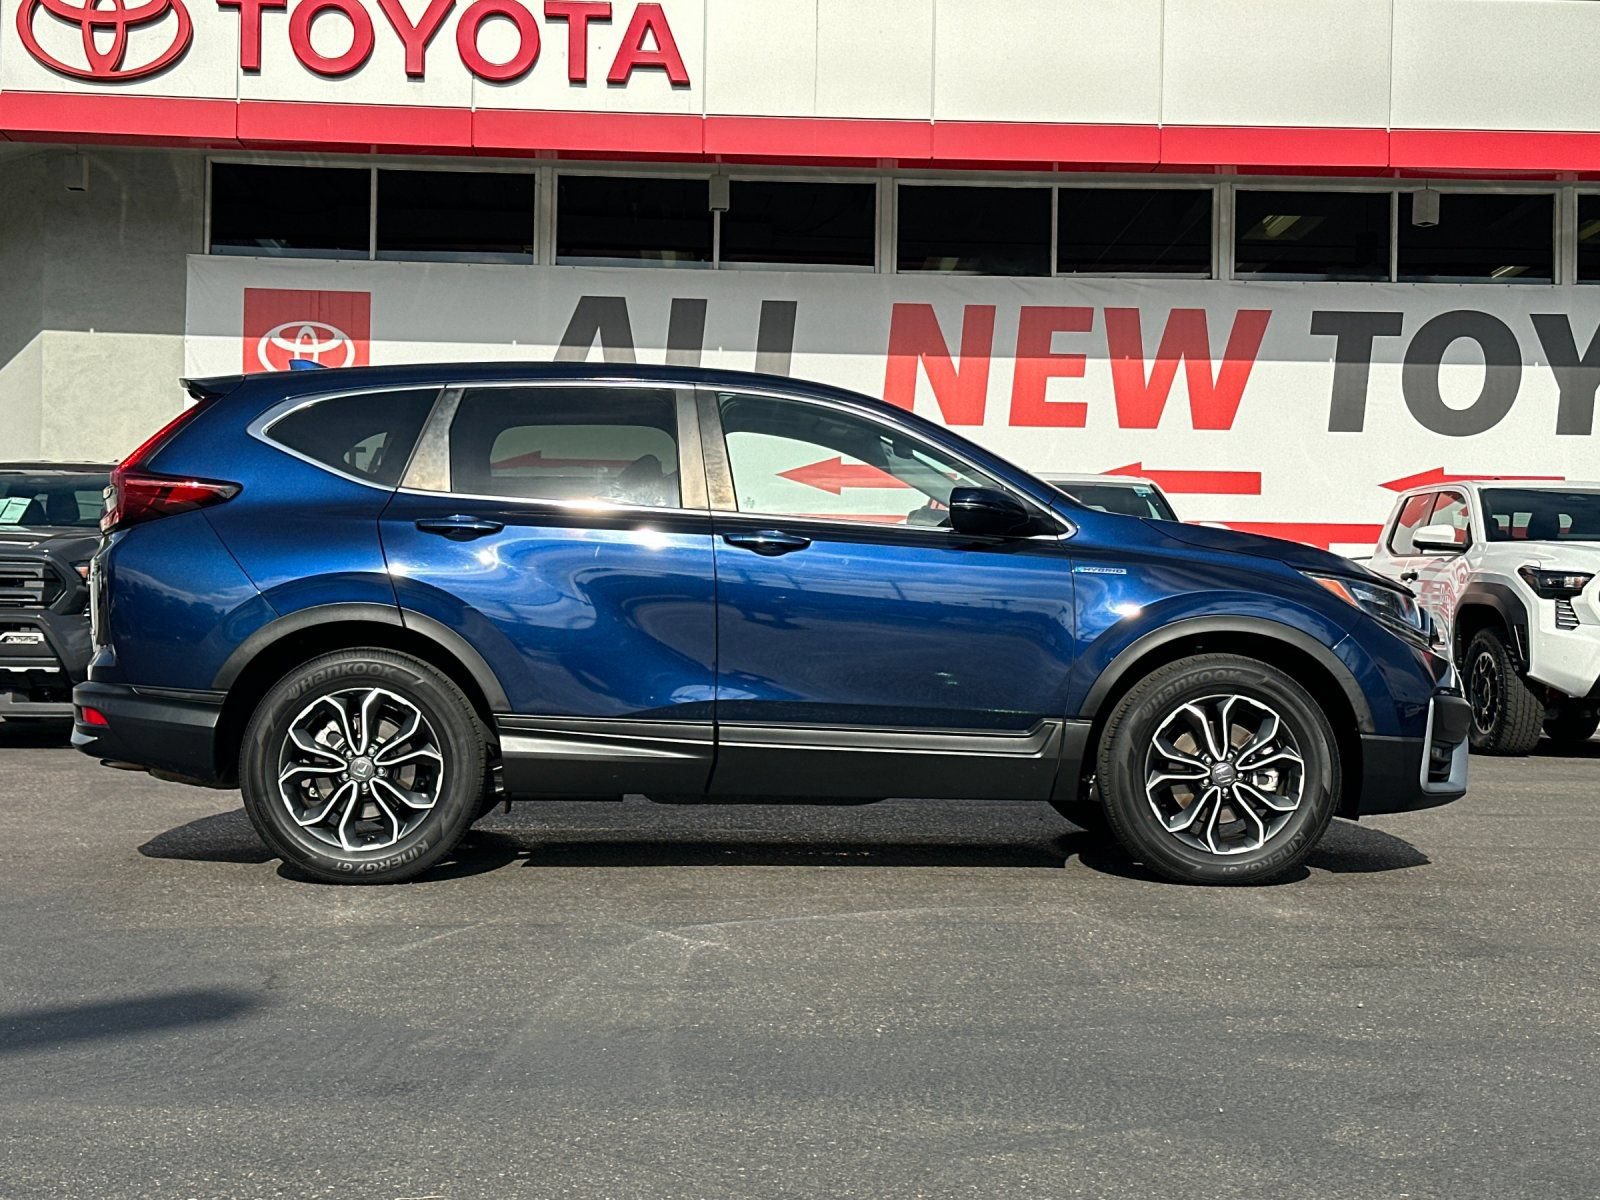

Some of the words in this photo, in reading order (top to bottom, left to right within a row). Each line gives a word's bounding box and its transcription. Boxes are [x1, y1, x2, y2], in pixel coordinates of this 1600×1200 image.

[215, 0, 691, 86] TOYOTA
[883, 303, 1273, 430] NEW
[1310, 309, 1600, 437] TOY
